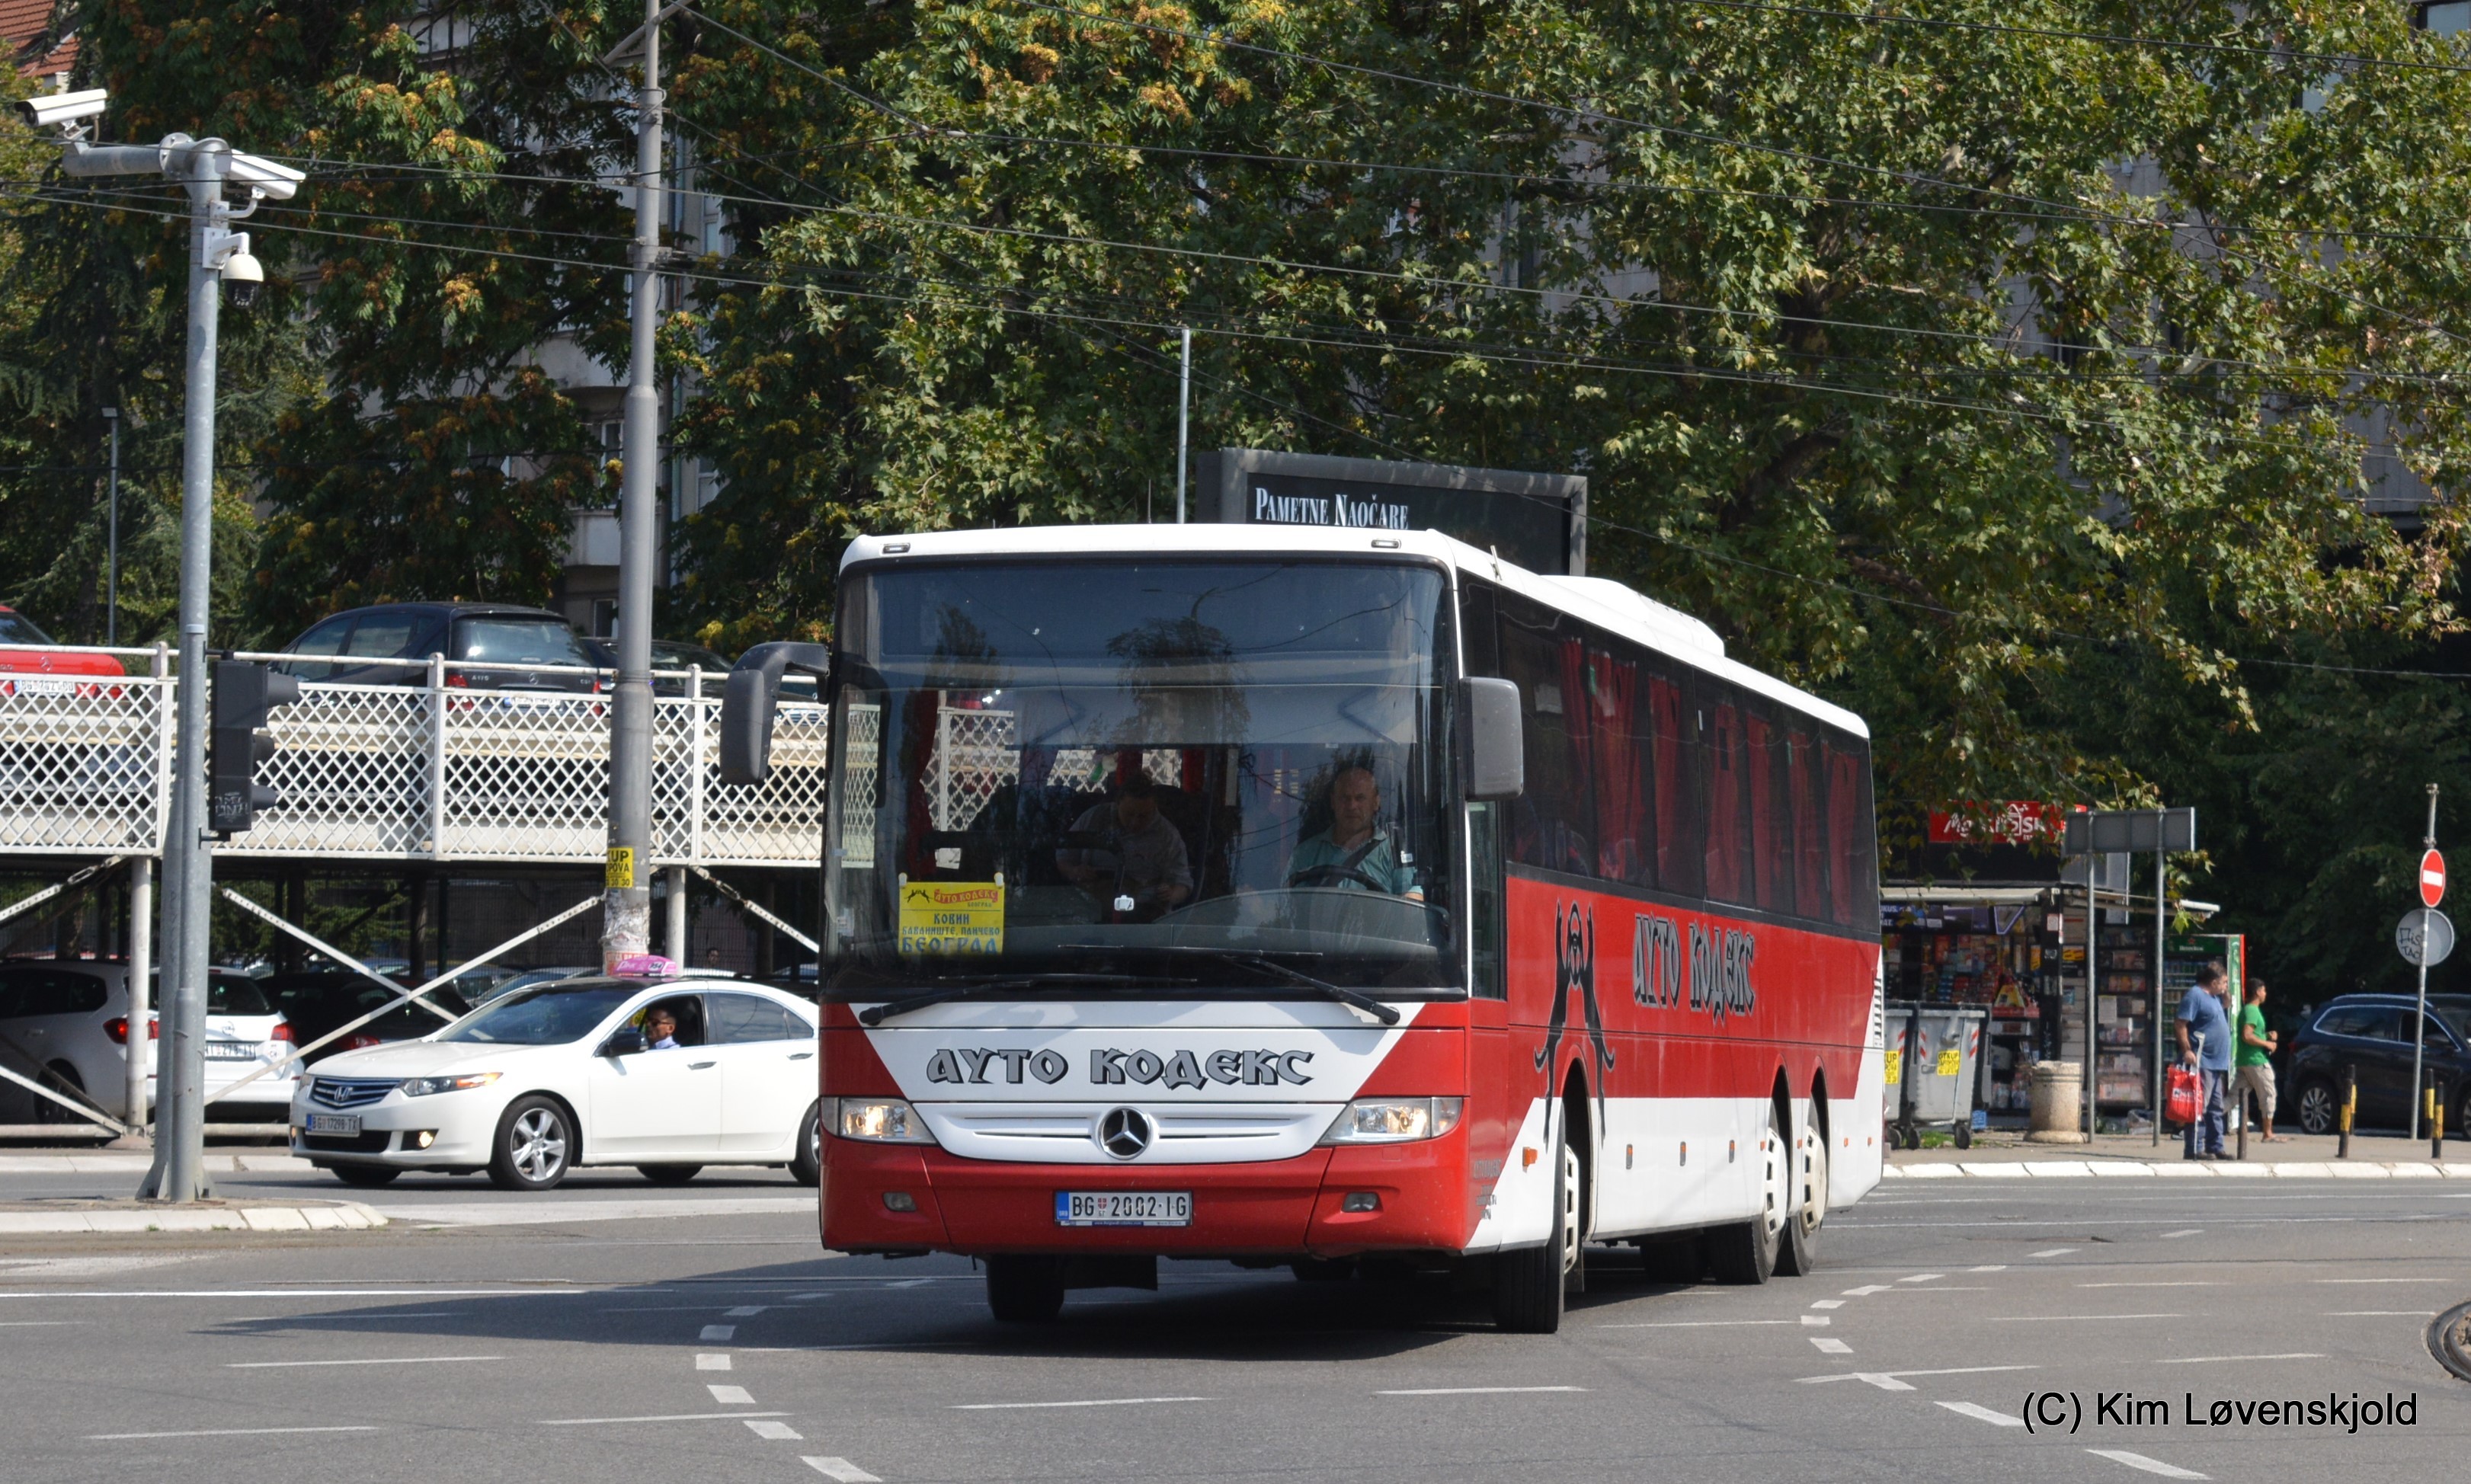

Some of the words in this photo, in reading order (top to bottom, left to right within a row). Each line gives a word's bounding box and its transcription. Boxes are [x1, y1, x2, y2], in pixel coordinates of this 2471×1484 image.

[1255, 488, 1329, 525] PAMETNE
[1334, 494, 1408, 530] NAOČARE
[934, 913, 969, 924] КОВИН
[902, 937, 998, 955] БЕОГРАД
[927, 1047, 1068, 1085] АУТО
[1090, 1047, 1315, 1091] КОДЕКС
[1073, 1196, 1094, 1217] BG
